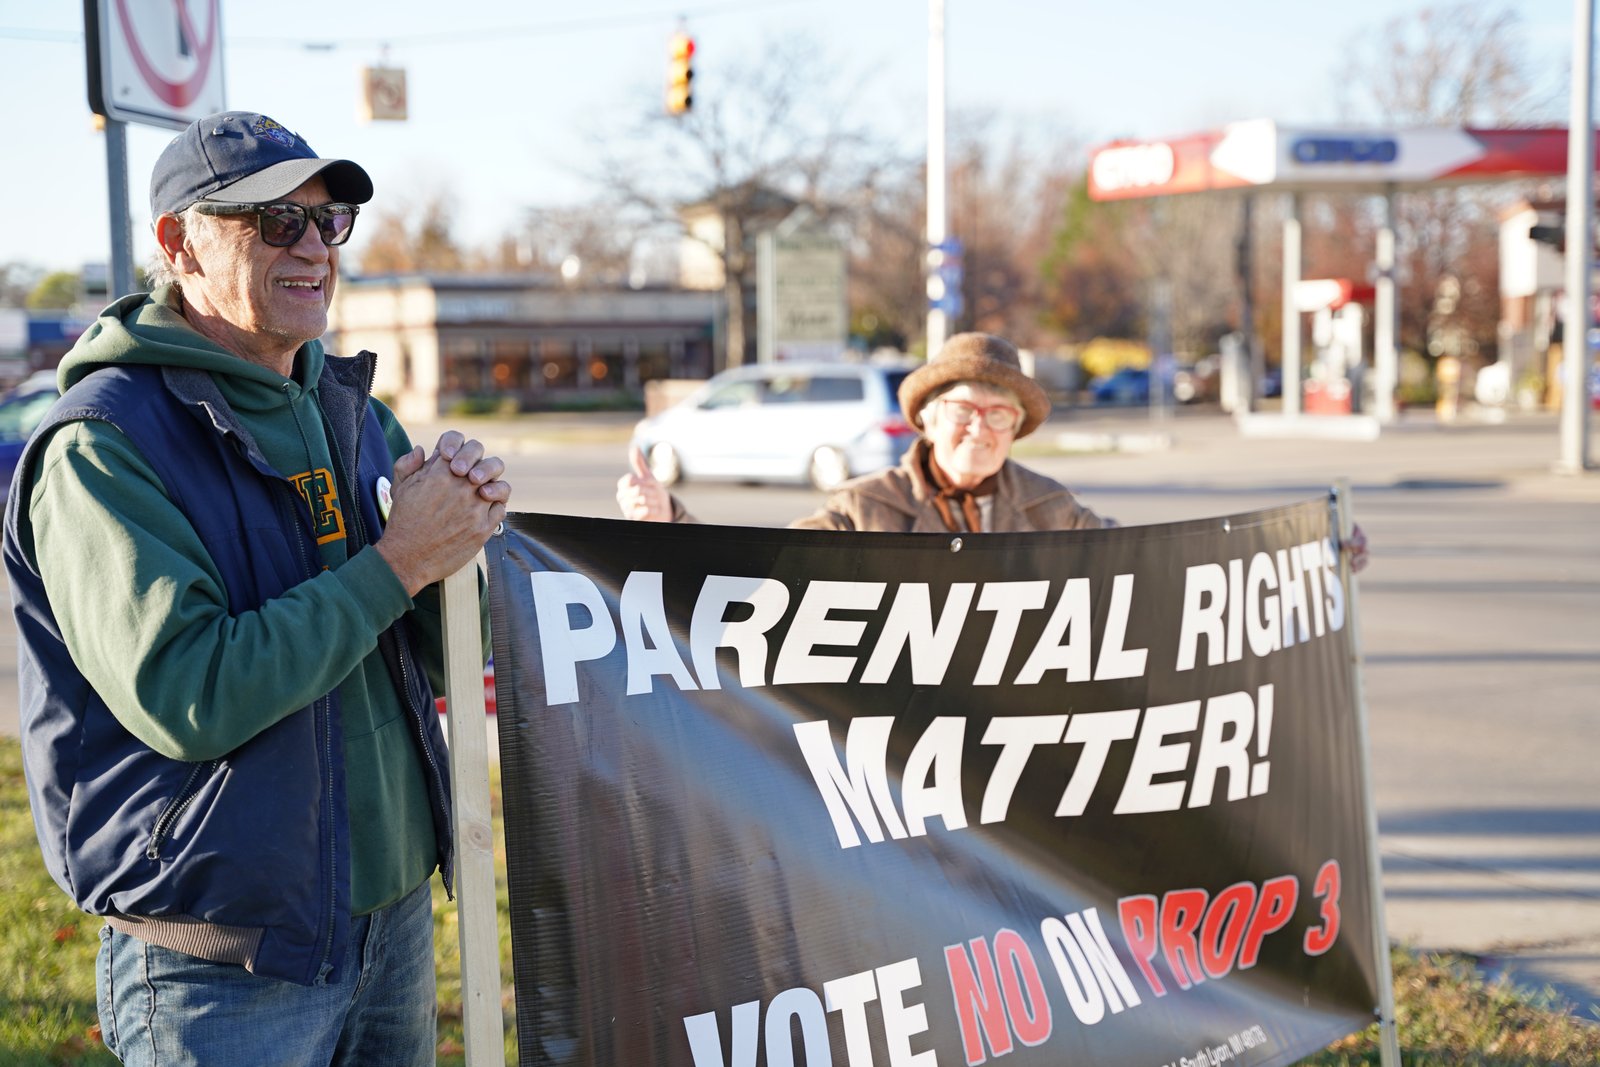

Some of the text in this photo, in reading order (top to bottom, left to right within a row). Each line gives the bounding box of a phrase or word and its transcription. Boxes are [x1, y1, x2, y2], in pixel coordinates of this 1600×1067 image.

[530, 536, 1345, 706] PARENTAL RIGHTS
[792, 683, 1275, 850] MATTER!
[683, 859, 1341, 1067] VOTE NO ON PROP 3
